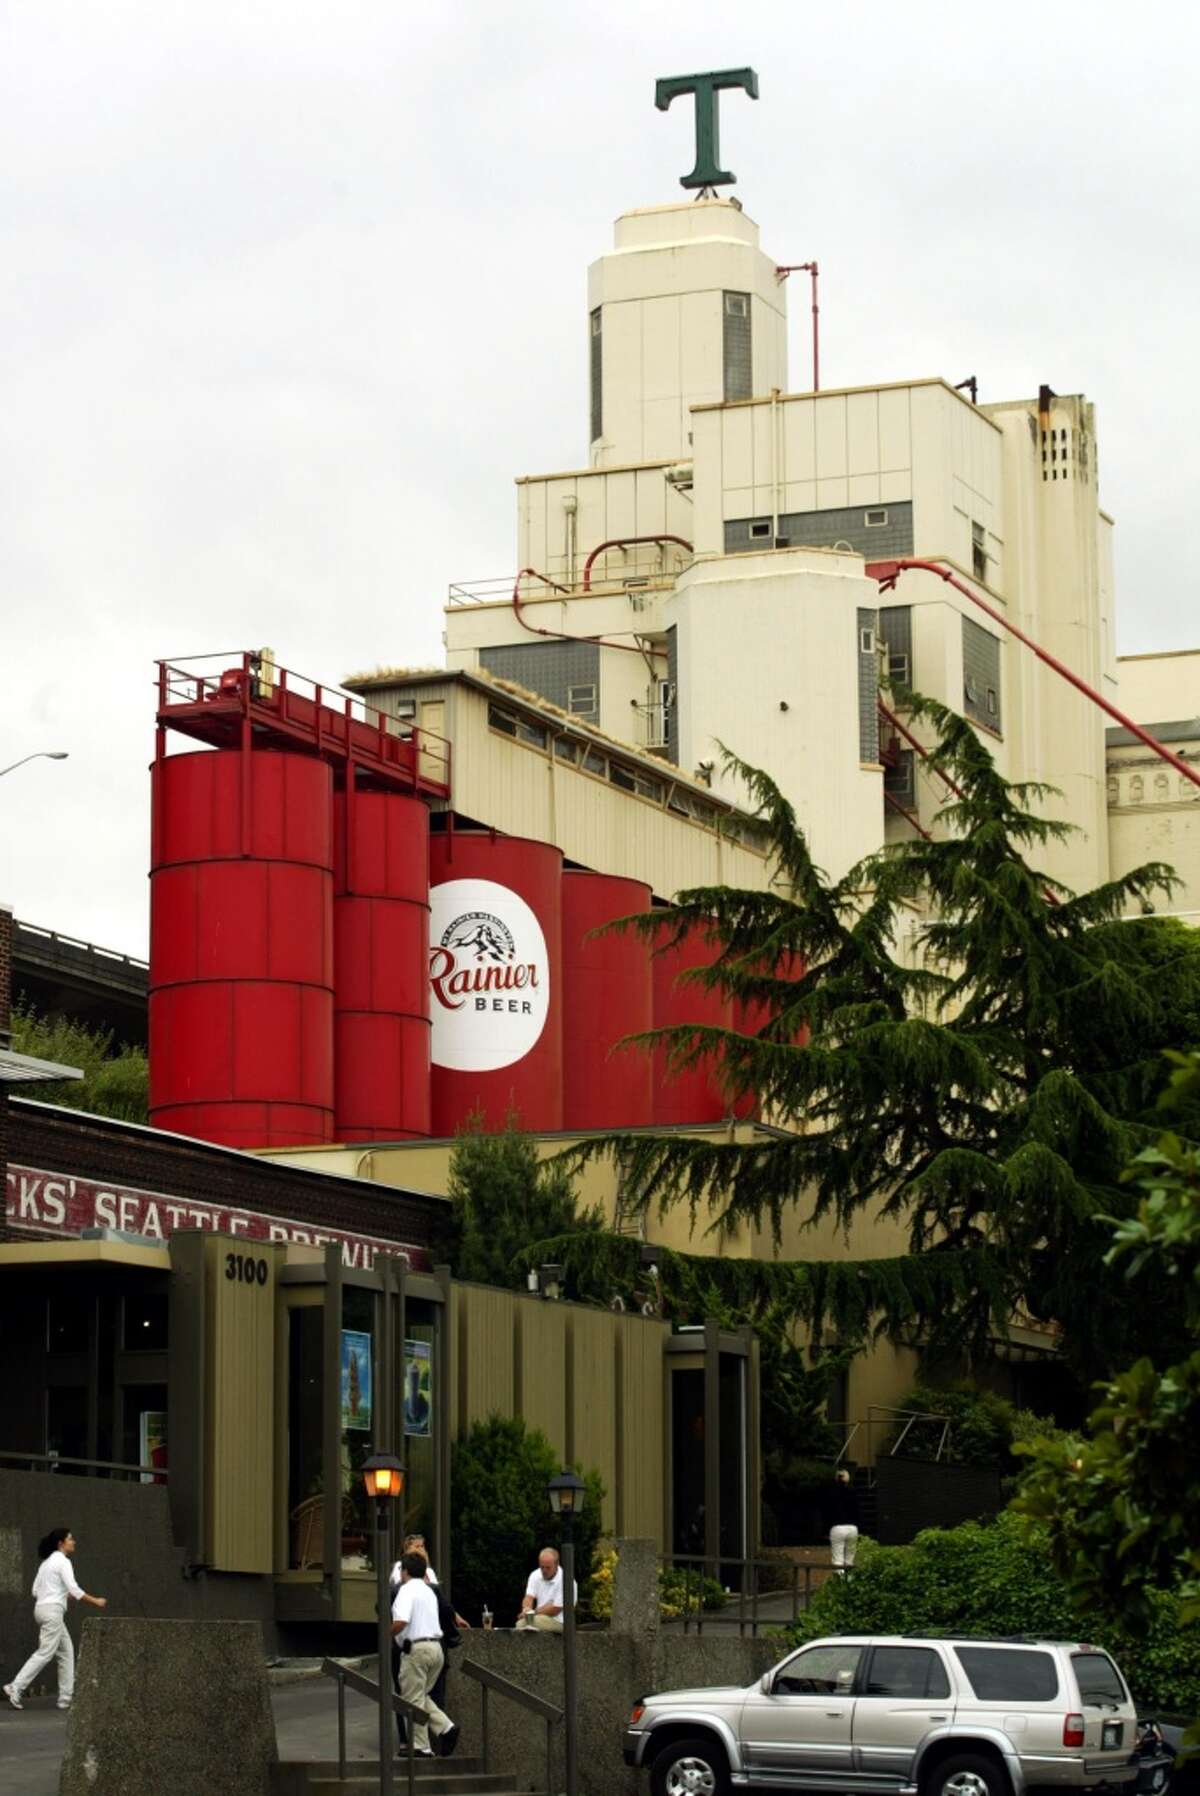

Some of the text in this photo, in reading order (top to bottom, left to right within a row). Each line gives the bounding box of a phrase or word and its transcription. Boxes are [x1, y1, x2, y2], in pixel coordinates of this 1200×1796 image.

[654, 66, 759, 190] T
[429, 946, 539, 1011] Rainier
[475, 997, 533, 1015] BEER
[225, 1253, 268, 1287] 3100
